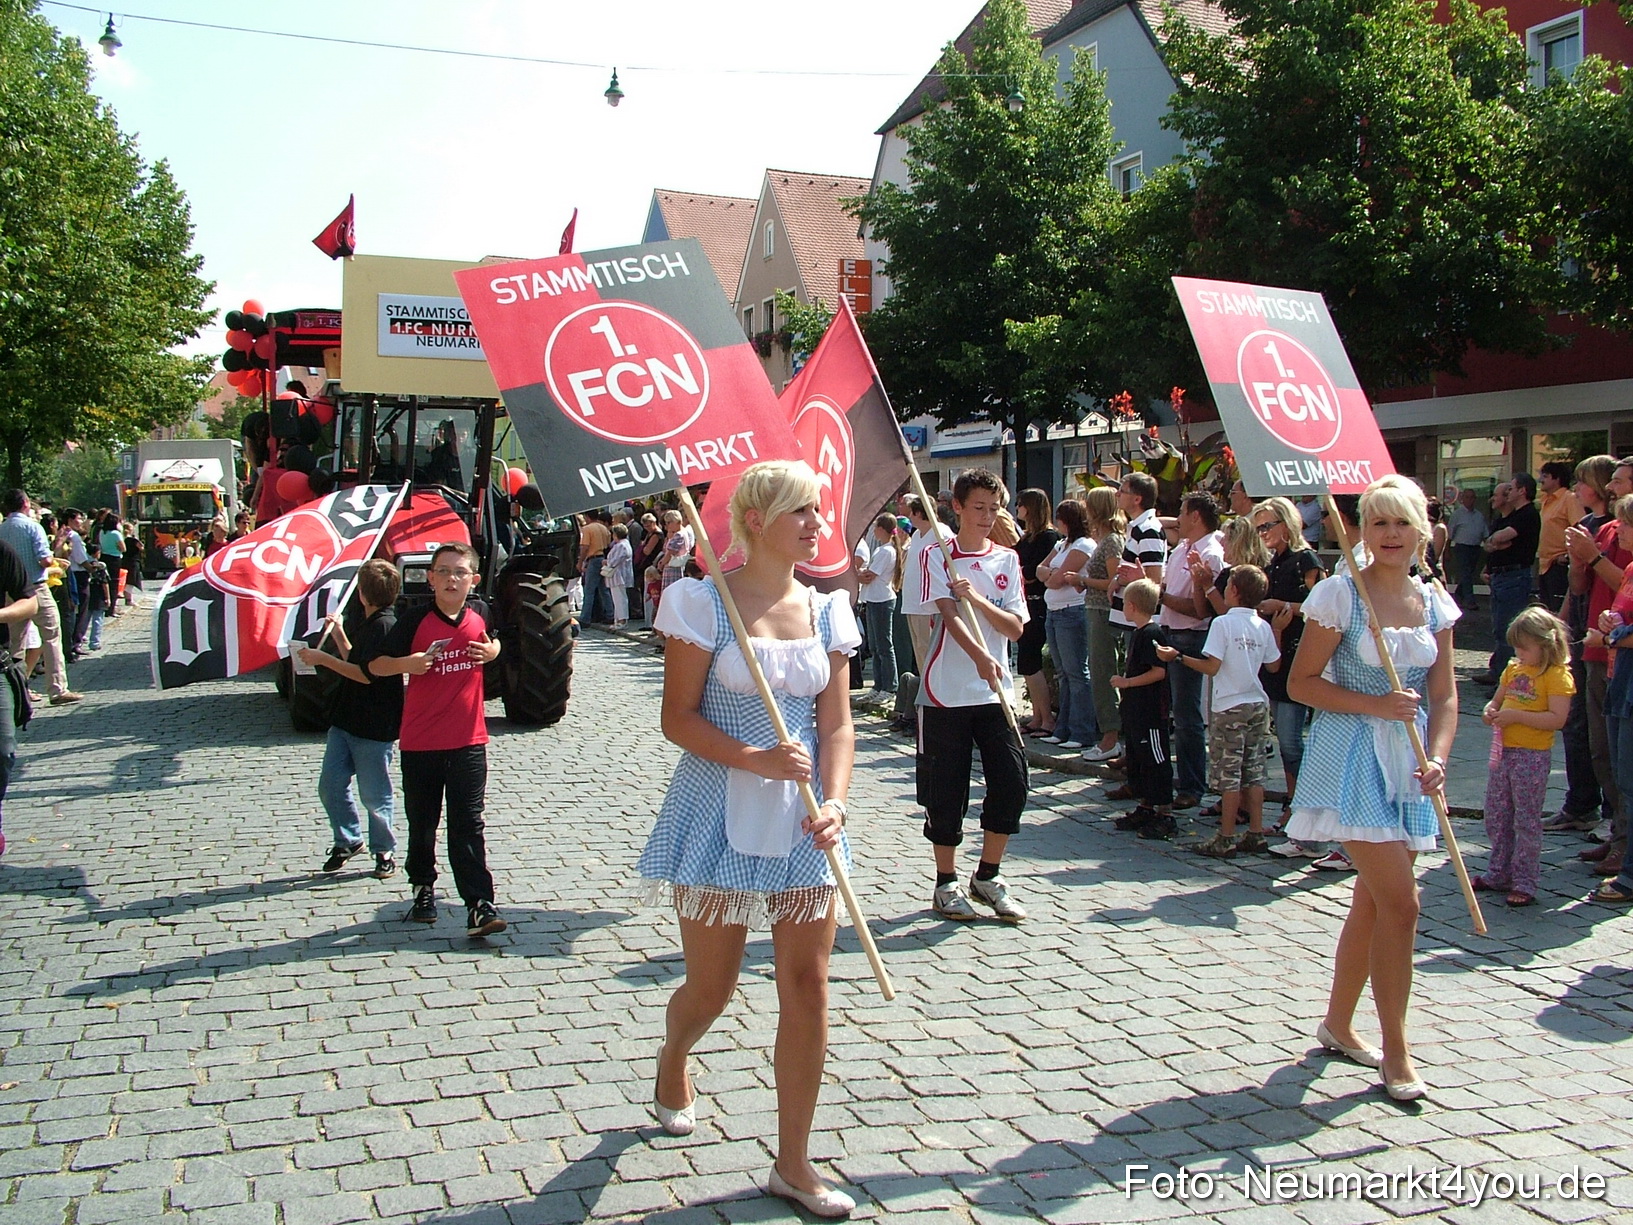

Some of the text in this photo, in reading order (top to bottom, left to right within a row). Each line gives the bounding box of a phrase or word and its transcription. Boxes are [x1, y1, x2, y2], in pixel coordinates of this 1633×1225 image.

[490, 252, 690, 305] STAMMTISCH
[1196, 290, 1321, 324] STAMMTISCH
[589, 315, 638, 358] 1.
[1263, 340, 1295, 378] 1.
[567, 352, 700, 417] FCN
[1252, 382, 1336, 422] FCN
[579, 431, 759, 497] NEUMARKT
[1264, 460, 1375, 486] NEUMARKT
[270, 516, 297, 541] 1.
[220, 539, 324, 584] FCN
[442, 661, 472, 675] jeans
